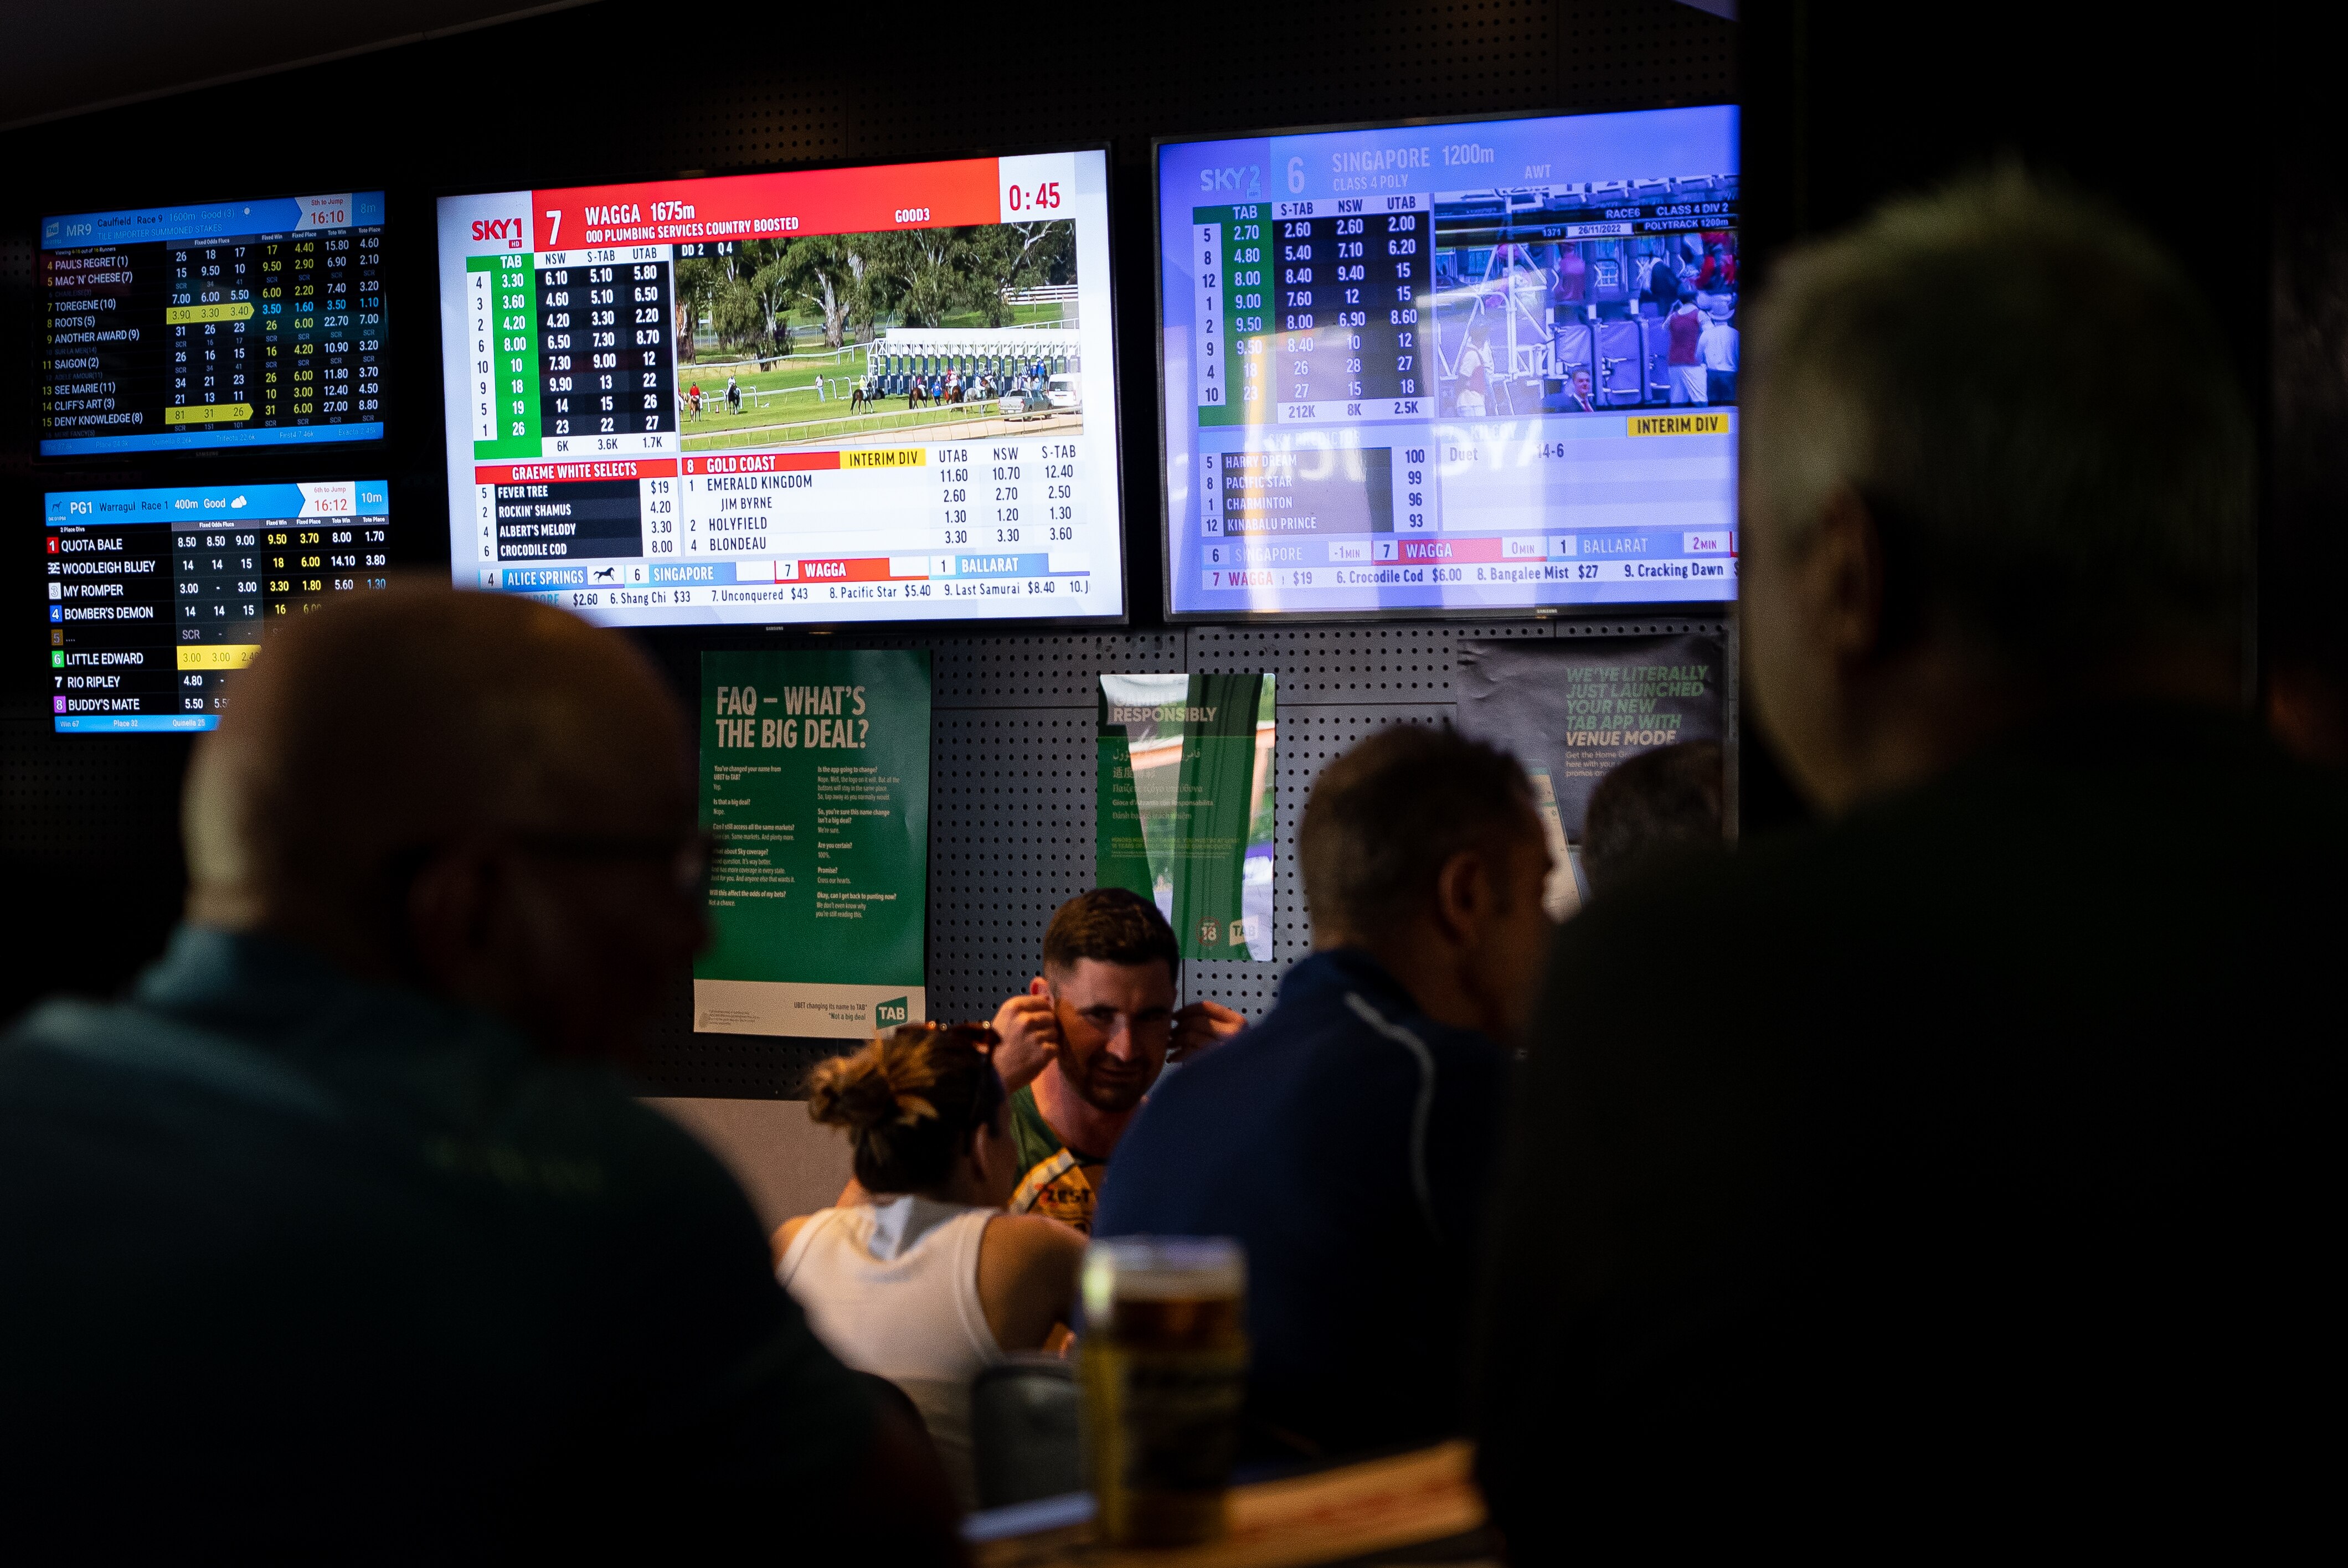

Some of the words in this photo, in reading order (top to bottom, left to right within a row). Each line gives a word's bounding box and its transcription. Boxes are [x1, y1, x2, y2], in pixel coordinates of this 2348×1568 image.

[1288, 157, 1305, 194] 6
[1332, 147, 1430, 173] SINGAPORE
[1442, 143, 1495, 164] 1200m
[1525, 164, 1551, 178] AWT
[1333, 177, 1367, 191] CLASS
[1371, 176, 1377, 188] 4
[1380, 174, 1408, 188] POLY
[1009, 182, 1060, 211] 0:45
[361, 203, 376, 213] 8m
[895, 208, 930, 223] GOOD3
[1656, 205, 1691, 216] CLASS
[1694, 205, 1700, 213] 4
[1702, 203, 1718, 214] DIV
[1721, 203, 1728, 212] 2
[66, 224, 92, 237] MR9
[97, 217, 131, 227] Caulfield
[137, 215, 155, 225] Race
[158, 214, 163, 224] 9
[169, 211, 195, 221] 1600m
[202, 209, 221, 219] Good
[224, 209, 234, 219] (3)
[311, 210, 344, 224] 16:10
[546, 210, 562, 245] 7
[585, 205, 640, 226] WAGGA
[651, 201, 695, 221] 1675m
[1645, 219, 1698, 231] POLYTRACK
[1701, 218, 1728, 227] 1200m
[605, 228, 655, 242] PLUMBING
[658, 224, 703, 239] SERVICES
[706, 221, 750, 236] COUNTRY
[754, 216, 799, 233] BOOSTED
[1578, 225, 1621, 234] 26/11/2022
[55, 259, 82, 270] PAUL'S
[84, 257, 115, 267] REGRET
[117, 255, 128, 268] (1)
[501, 256, 522, 268] TAB
[545, 252, 565, 264] NSW
[587, 250, 615, 262] S-TAB
[633, 247, 657, 259] UTAB
[55, 275, 73, 286] MAC
[76, 274, 86, 285] 'N'
[89, 273, 120, 284] CHEESE
[122, 271, 132, 283] (7)
[502, 274, 524, 287] 3.30
[545, 271, 567, 285] 6.10
[590, 268, 612, 282] 5.10
[634, 266, 656, 279] 5.80
[55, 416, 75, 427] DENY
[78, 413, 130, 426] KNOWLEDGE
[132, 412, 143, 425] (8)
[1638, 418, 1691, 432] INTERIM
[1696, 417, 1718, 431] DIV
[707, 458, 737, 472] GOLD
[740, 456, 775, 471] COAST
[849, 453, 895, 466] INTERIM
[899, 451, 917, 464] DIV
[1226, 456, 1258, 468] HARRY
[1262, 455, 1297, 467] DREAM
[512, 465, 555, 481] GRAEME
[558, 463, 591, 478] WHITE
[594, 462, 637, 477] SELECTS
[498, 487, 525, 499] FEVER
[527, 486, 548, 497] TREE
[651, 481, 669, 494] $19
[708, 478, 758, 492] EMERALD
[761, 474, 812, 489] KINGDOM
[315, 499, 348, 511] 16:12
[362, 493, 382, 503] 10m
[1227, 497, 1293, 510] CHARMINTON
[70, 502, 92, 514] PG1
[100, 502, 136, 513] Warragul
[141, 502, 160, 510] Race
[164, 501, 168, 510] 1
[175, 499, 198, 509] 400m
[204, 498, 226, 508] Good
[499, 506, 534, 518] ROCKIN'
[535, 504, 571, 517] SHAMUS
[500, 525, 539, 537] ALBERT'S
[542, 523, 576, 536] MELODY
[1228, 518, 1278, 532] KINABALU
[1281, 517, 1317, 530] PRINCE
[61, 540, 95, 551] QUOTA
[97, 539, 122, 550] BALE
[501, 544, 548, 557] CROCODILE
[550, 543, 567, 555] COD
[710, 537, 766, 551] BLONDEAU
[1405, 542, 1453, 558] WAGGA
[1584, 538, 1648, 554] BALLARAT
[63, 563, 122, 574] WOODLEIGH
[125, 561, 155, 572] BLUEY
[805, 563, 846, 577] WAGGA
[962, 558, 1018, 572] BALLARAT
[508, 572, 537, 586] ALICE
[539, 569, 584, 584] SPRINGS
[654, 566, 713, 582] SINGAPORE
[1350, 569, 1400, 583] Crocodile
[1404, 569, 1423, 582] Cod
[1490, 568, 1541, 582] Bangalee
[1544, 566, 1569, 579] Mist
[1579, 565, 1599, 579] $27
[1624, 565, 1635, 577] 9.
[1638, 564, 1688, 578] Cracking
[1692, 563, 1723, 576] Dawn
[712, 591, 718, 601] 7.
[722, 589, 784, 604] Unconquered
[791, 588, 808, 600] $43
[830, 587, 837, 599] 8.
[841, 586, 872, 599] Pacific
[877, 586, 897, 598] Star
[905, 585, 931, 598] $5.40
[945, 584, 952, 596] 9.
[956, 584, 976, 596] Last
[980, 582, 1020, 595] Samurai
[1028, 580, 1054, 595] $8.40
[65, 608, 113, 620] BOMBER'S
[116, 607, 153, 618] DEMON
[66, 654, 99, 665] LITTLE
[101, 653, 143, 664] EDWARD
[1622, 666, 1708, 681] LITERALLY
[1567, 684, 1606, 698] JUST
[1611, 682, 1705, 698] LAUNCHED
[717, 687, 756, 715] FAQ
[1567, 699, 1613, 714] YOUR
[1616, 699, 1657, 713] NEW
[1113, 707, 1217, 721] RESPONSIBLY
[1567, 716, 1597, 730] TAB
[1601, 715, 1633, 730] APP
[1639, 714, 1682, 729] WITH
[716, 719, 755, 747] THE
[761, 719, 797, 748] BIG
[805, 719, 869, 748] DEAL?
[1566, 731, 1621, 746] VENUE
[879, 1007, 905, 1020] TAB
